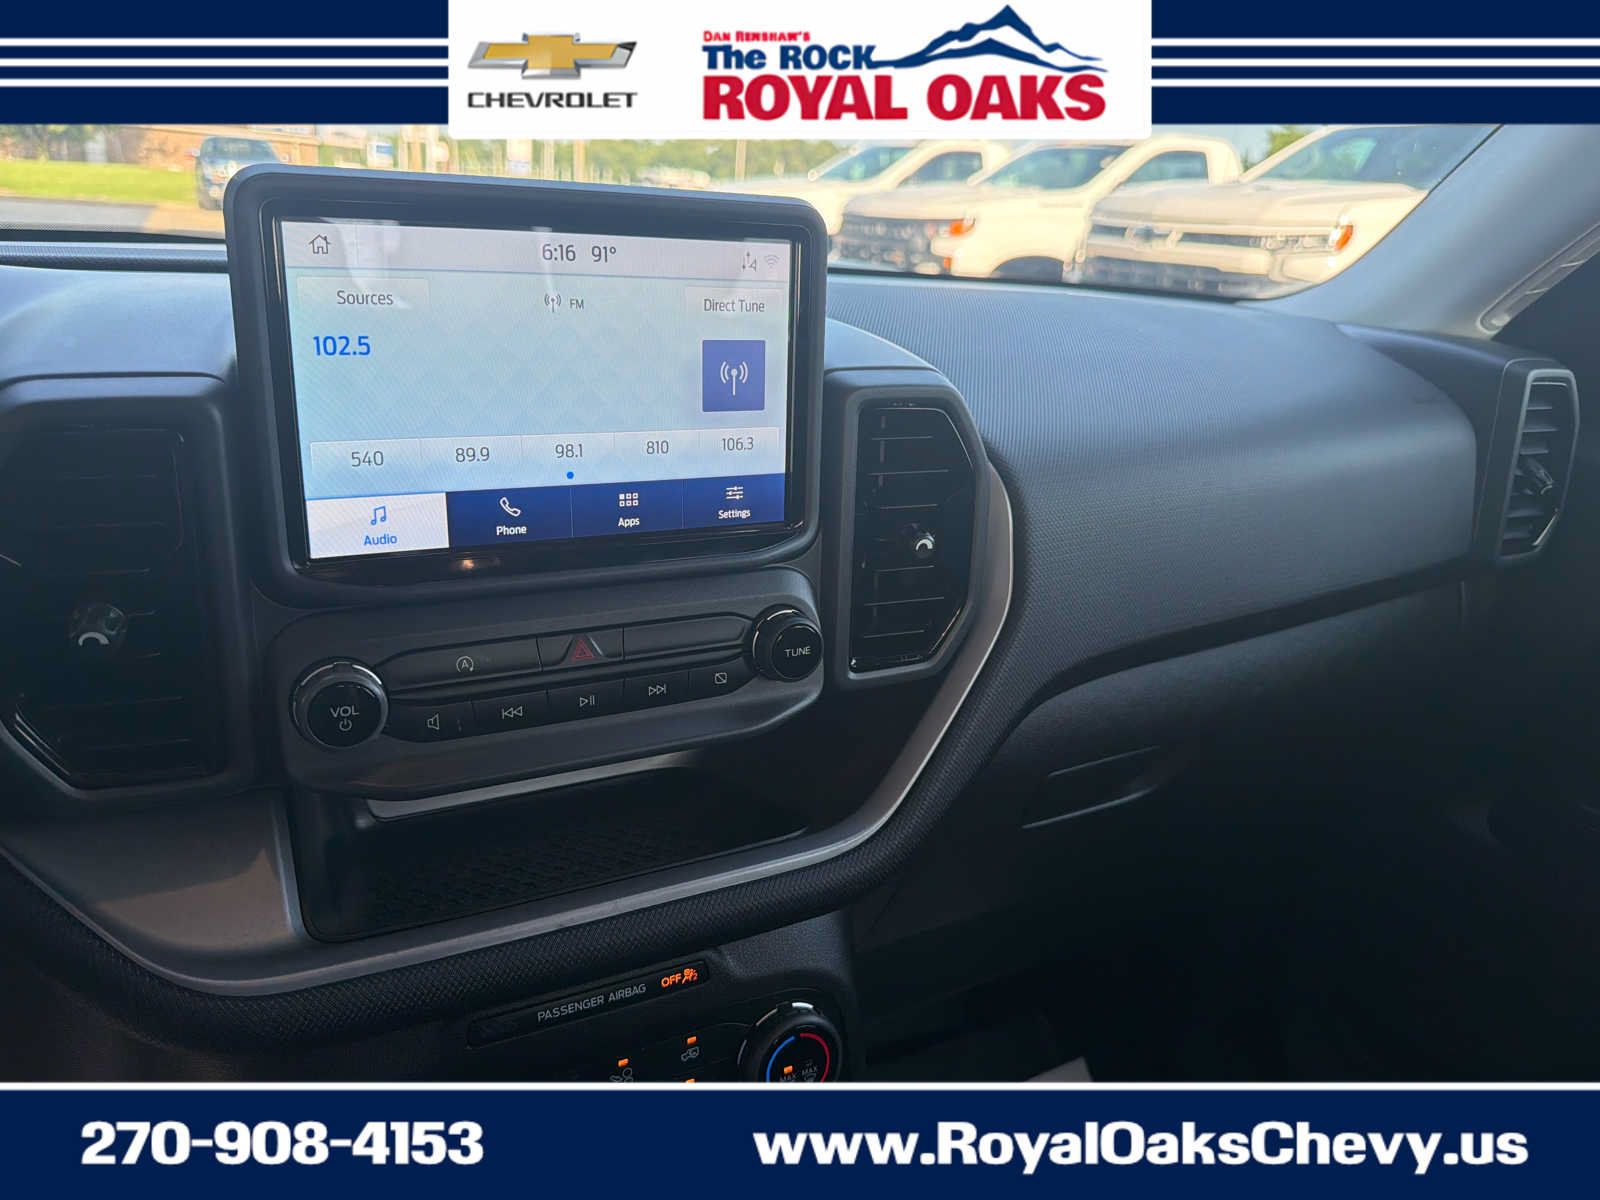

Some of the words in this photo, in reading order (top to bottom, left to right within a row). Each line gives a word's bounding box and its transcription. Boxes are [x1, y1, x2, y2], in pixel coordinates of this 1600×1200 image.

[542, 243, 577, 262] 6:16
[591, 245, 618, 263] 91°
[336, 289, 394, 306] Sources
[569, 298, 585, 310] FM
[703, 298, 736, 313] Direct
[738, 299, 765, 313] Tune
[313, 335, 371, 356] 102.5
[555, 443, 584, 459] 98.1
[646, 440, 669, 455] 810
[721, 436, 754, 451] 106.3
[351, 450, 384, 467] 540
[455, 446, 490, 463] 89.9
[718, 508, 751, 520] Settings
[495, 524, 527, 536] Phone
[617, 517, 640, 530] Apps
[363, 533, 398, 546] Audio
[784, 645, 811, 657] TUNE
[330, 704, 360, 718] VOL
[537, 995, 605, 1022] PASSENGER
[607, 983, 647, 1003] AIRBAG
[661, 973, 682, 988] OFF
